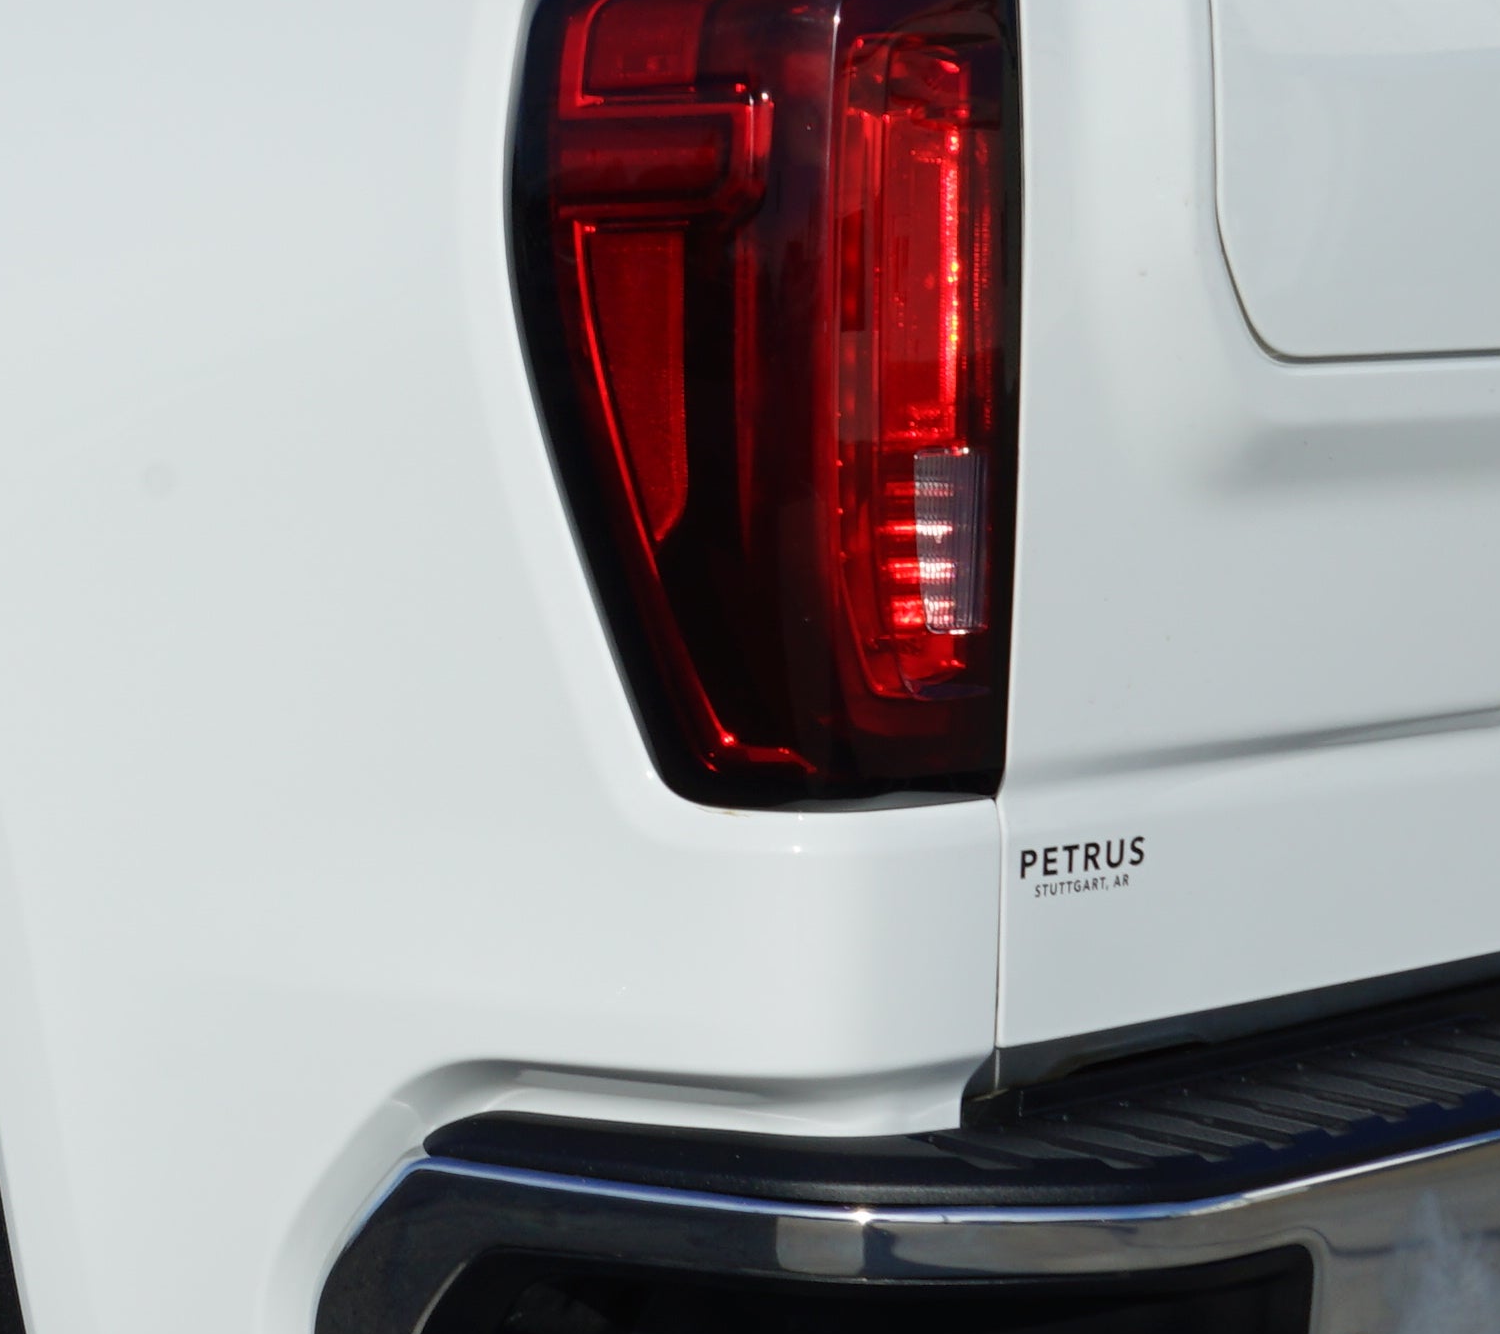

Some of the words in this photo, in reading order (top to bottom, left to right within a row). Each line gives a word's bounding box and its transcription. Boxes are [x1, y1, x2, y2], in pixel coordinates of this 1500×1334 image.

[1019, 835, 1146, 880] PETRUS
[1034, 876, 1110, 898] STUTTGART,
[1112, 873, 1130, 888] AR
